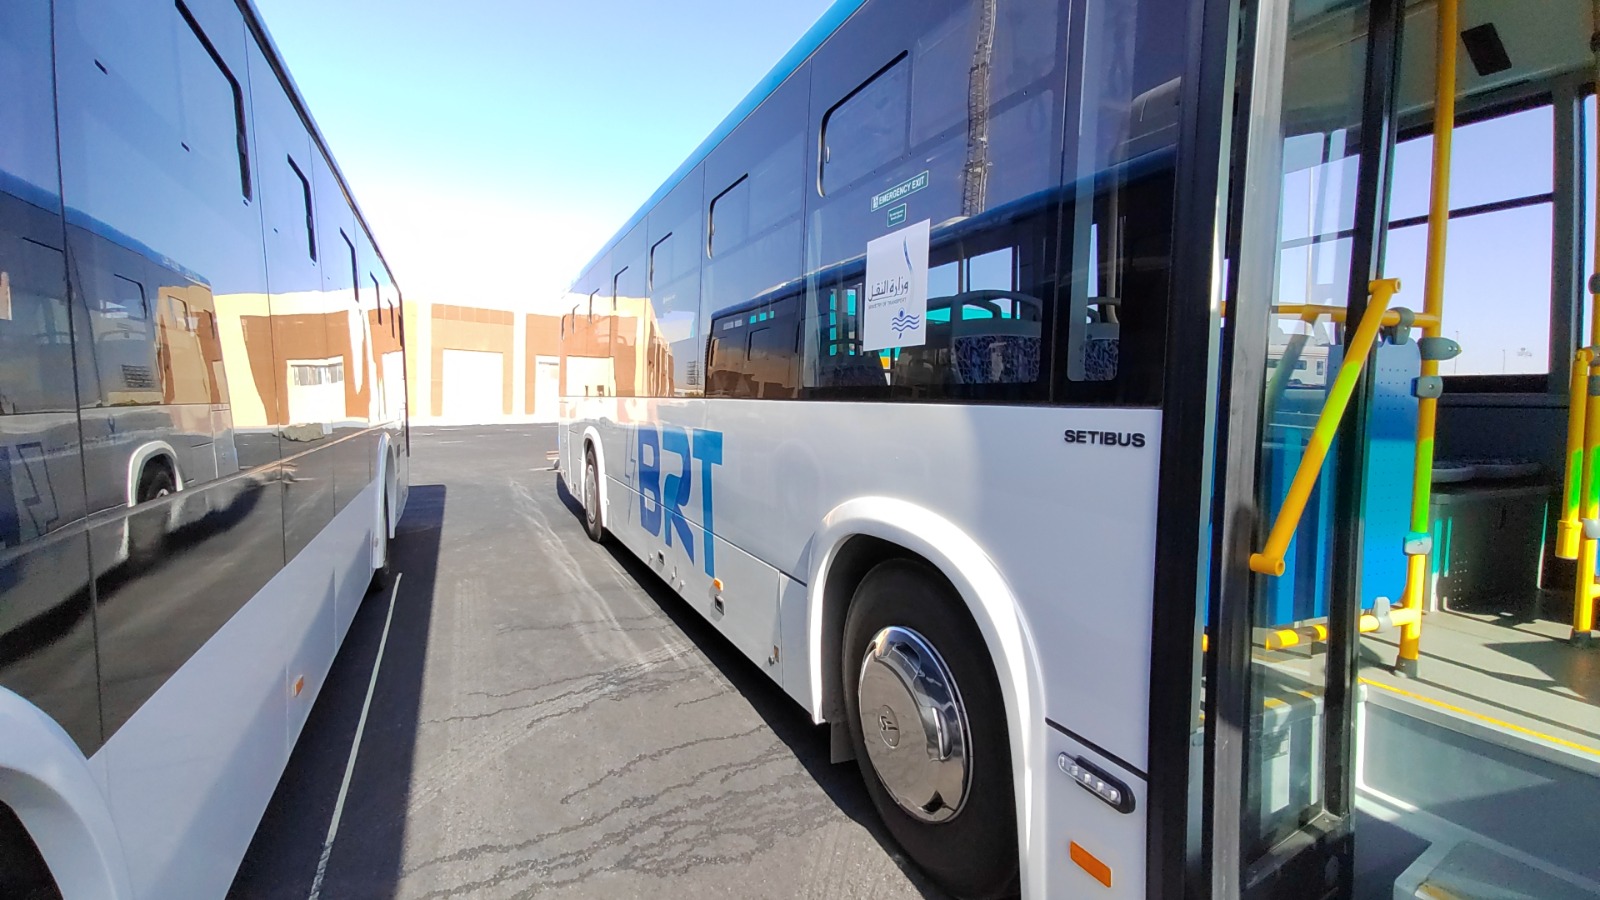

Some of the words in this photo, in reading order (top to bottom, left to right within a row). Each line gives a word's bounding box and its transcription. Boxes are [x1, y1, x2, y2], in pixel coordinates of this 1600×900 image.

[878, 183, 911, 205] EMERGENCY
[911, 175, 925, 190] EXIT
[868, 279, 889, 302] النقل
[889, 276, 909, 297] وزارة
[1063, 429, 1146, 448] SETIBUS
[638, 421, 723, 579] BRT
